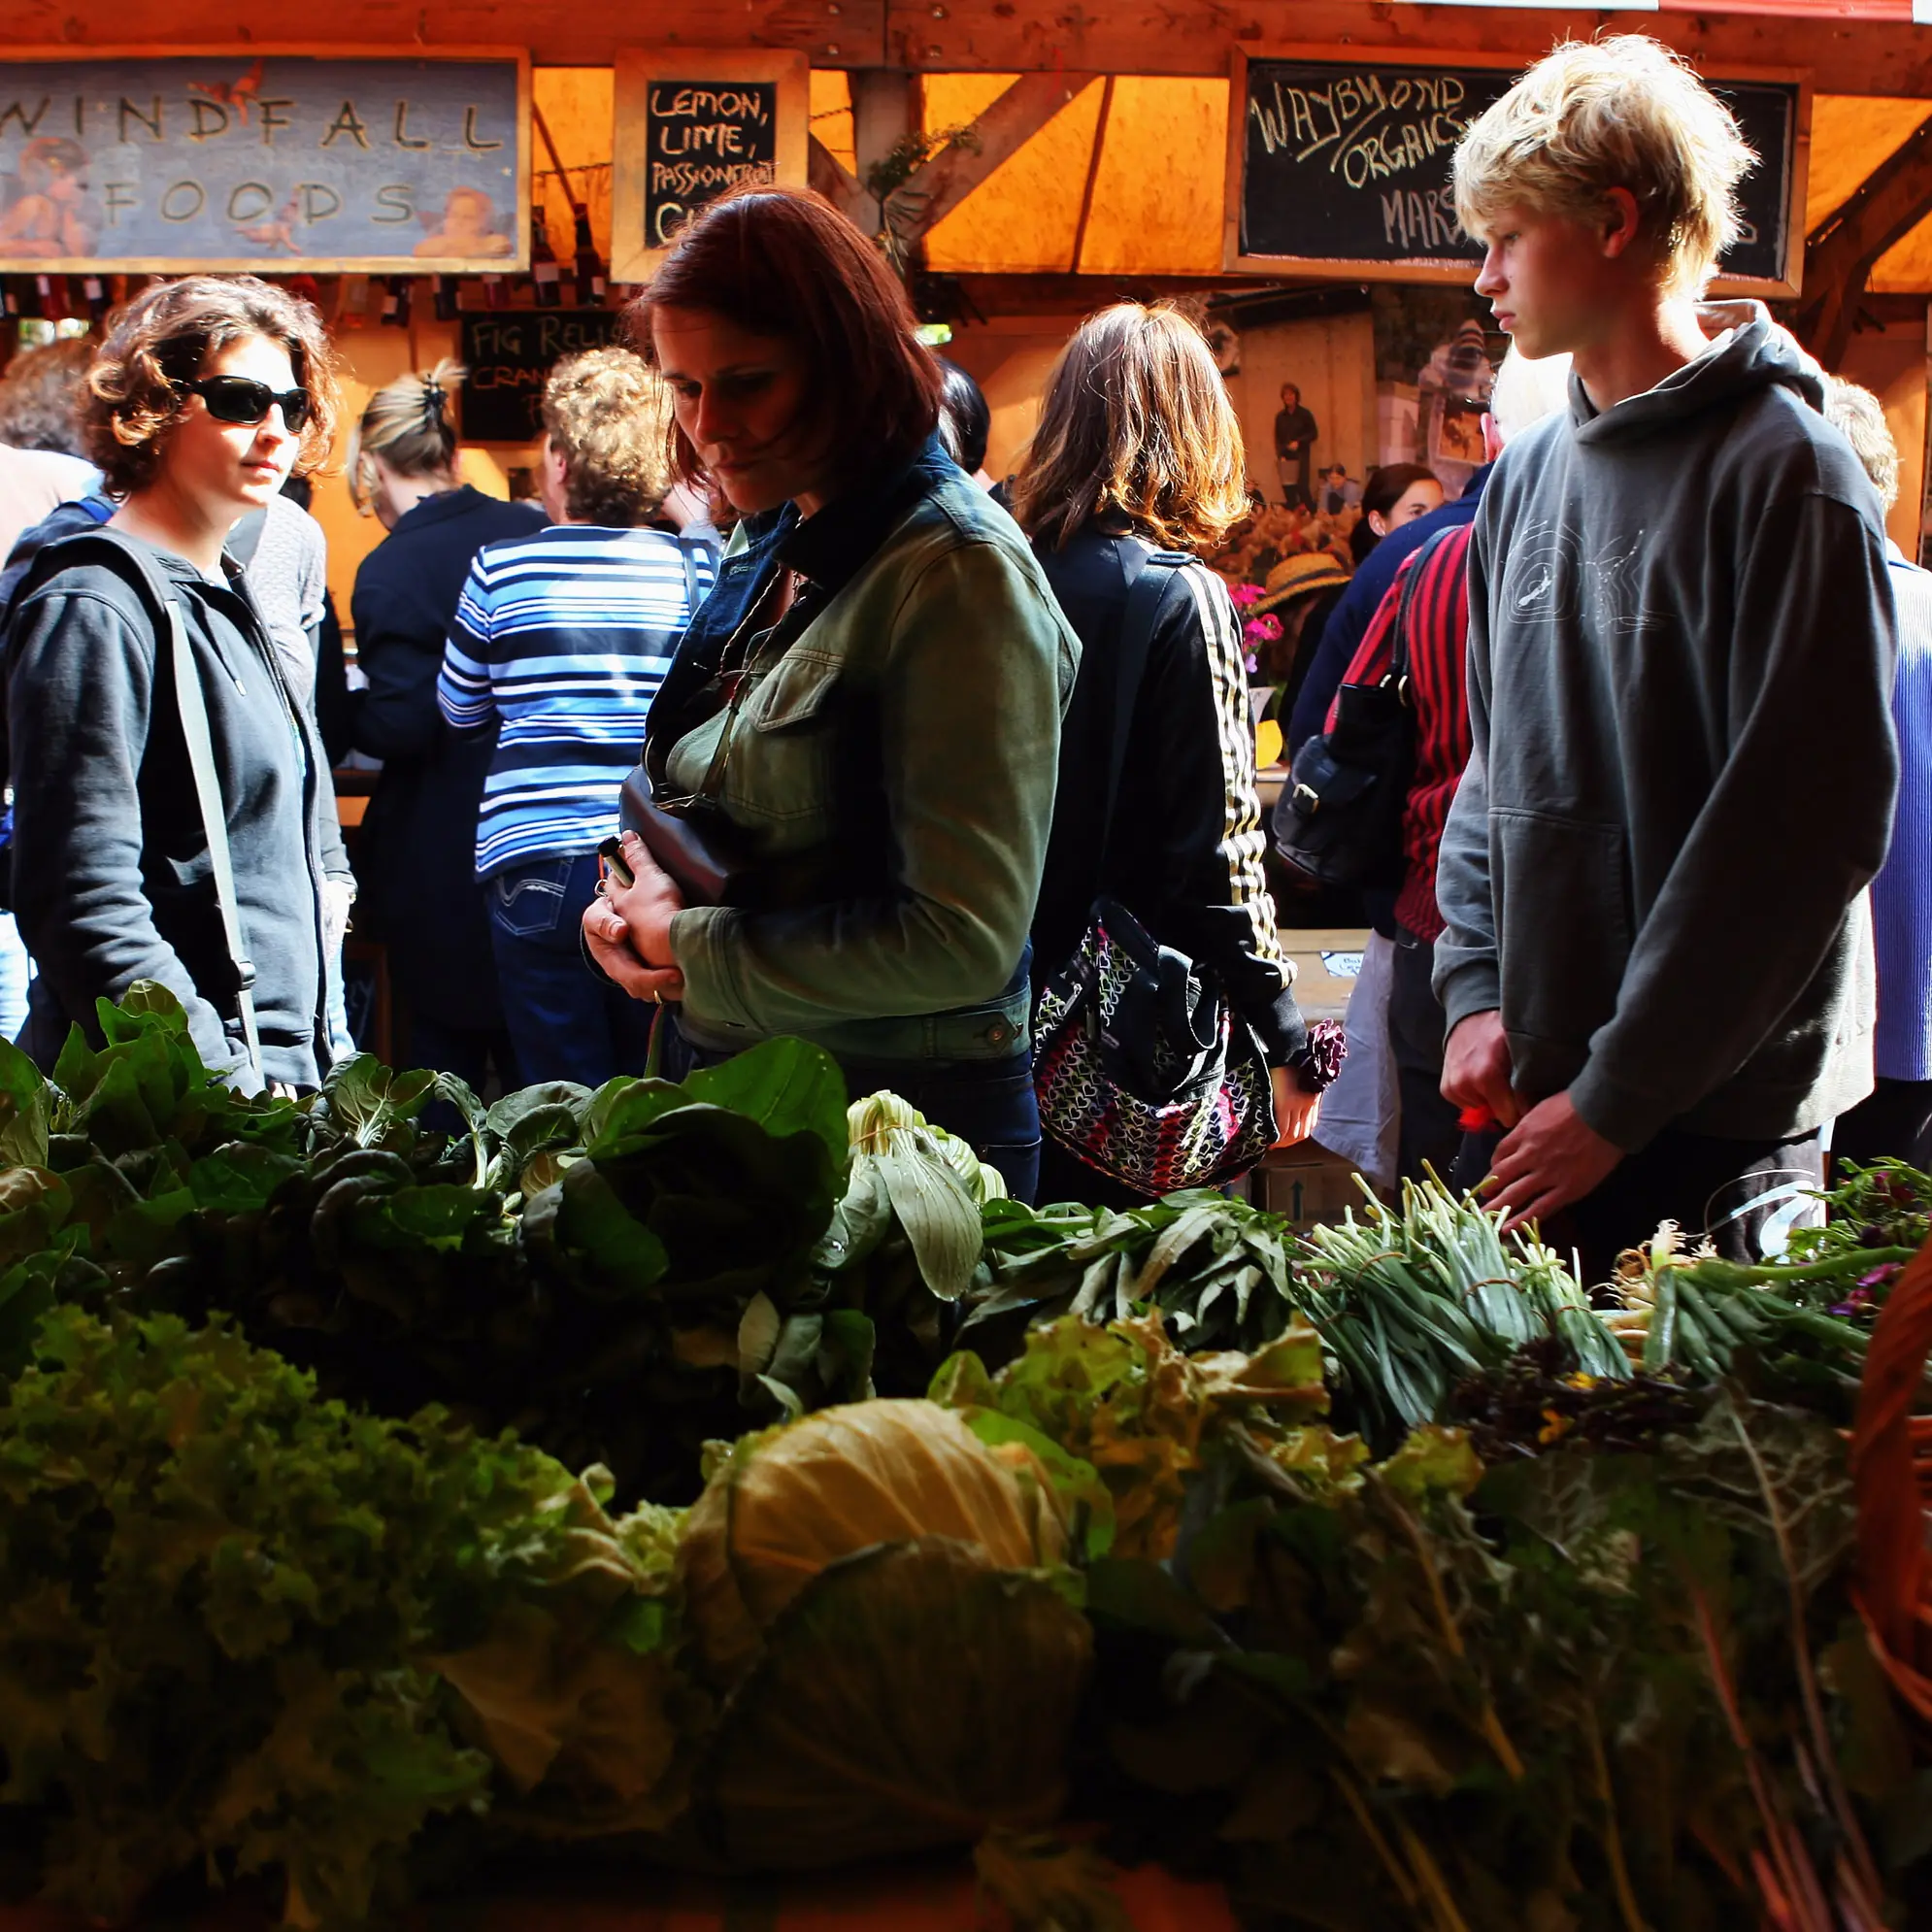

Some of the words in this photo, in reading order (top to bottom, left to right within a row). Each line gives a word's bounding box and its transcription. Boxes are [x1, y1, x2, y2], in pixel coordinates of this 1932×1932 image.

[0, 94, 502, 149] WINDFALL
[650, 88, 769, 127] LEMON,
[660, 122, 756, 159] LIME,
[103, 181, 414, 225] FOODS
[471, 321, 523, 357] FIG
